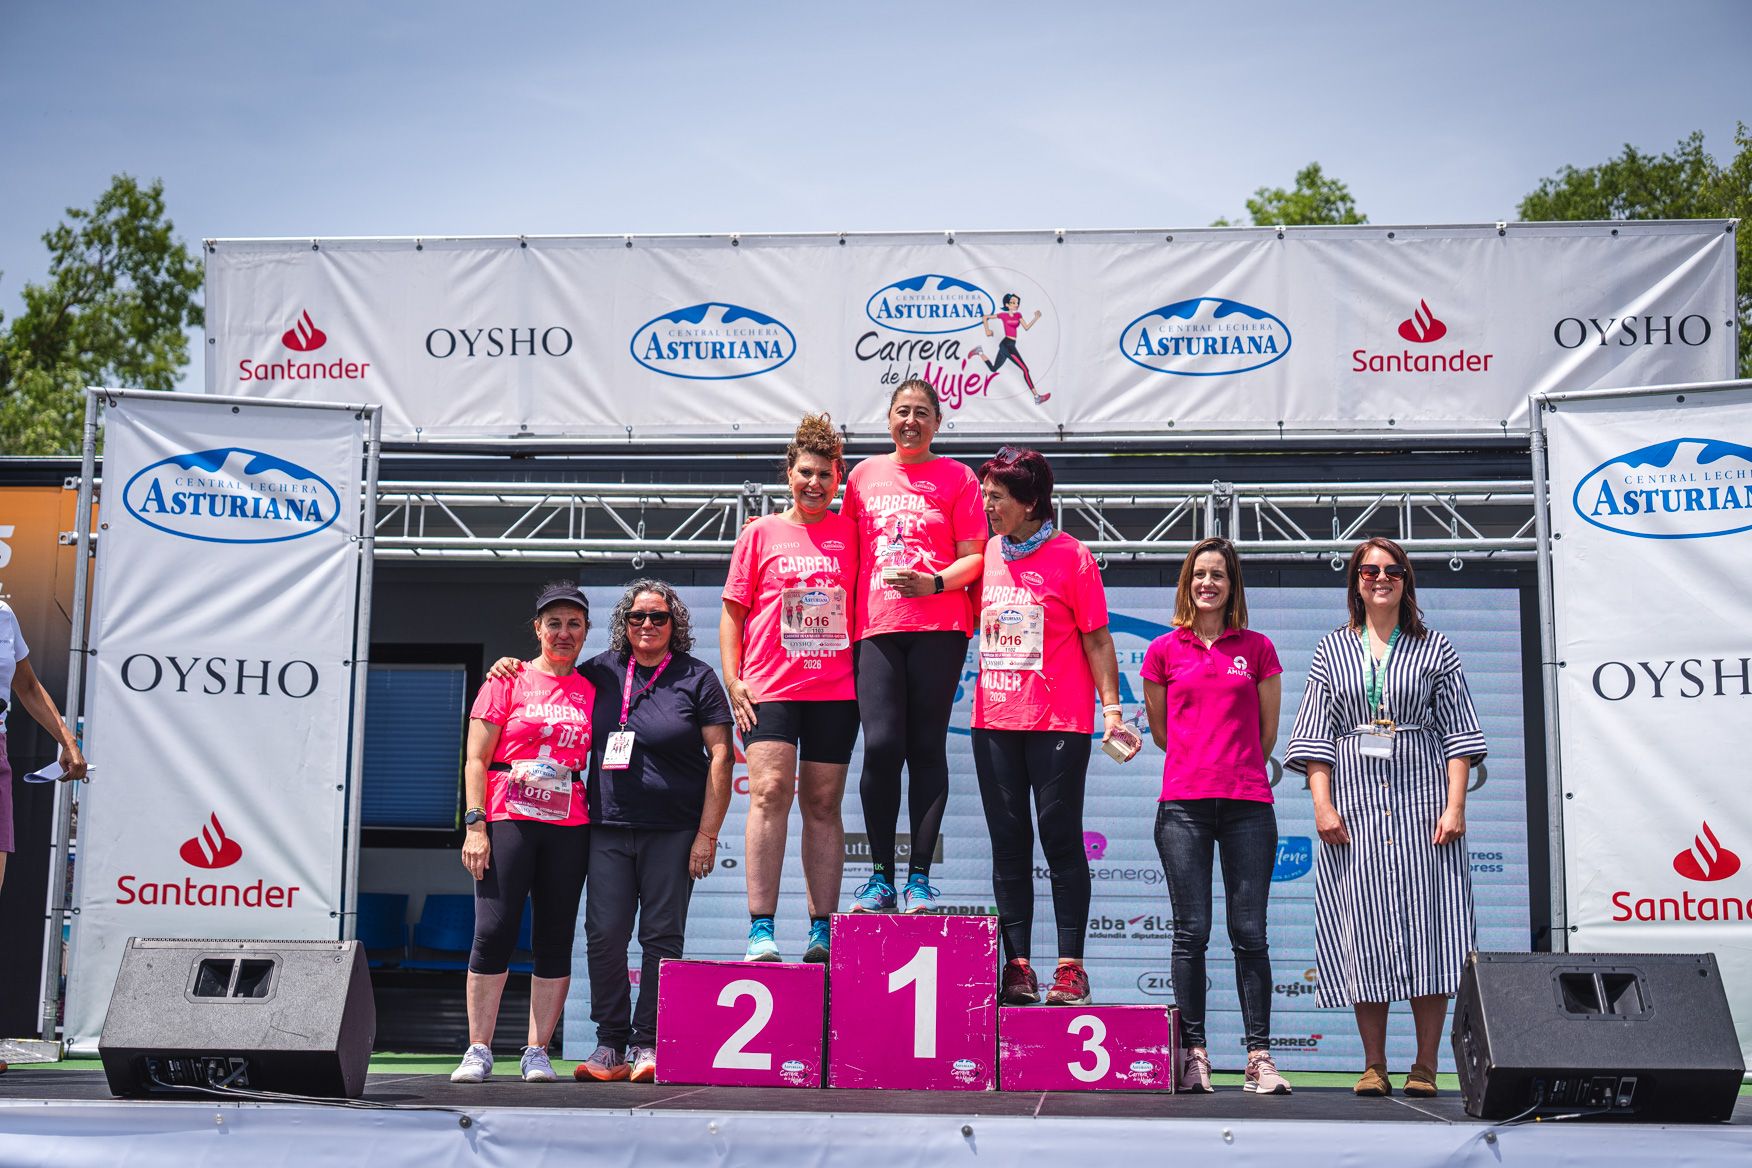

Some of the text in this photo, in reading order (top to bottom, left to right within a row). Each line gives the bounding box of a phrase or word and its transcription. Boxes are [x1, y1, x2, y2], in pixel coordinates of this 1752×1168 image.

[876, 297, 985, 319] ASTURIANA
[668, 328, 779, 337] CENTRAL LECHERA
[1159, 322, 1273, 333] CENTRAL LECHERA
[1553, 314, 1712, 349] OYSHO
[425, 326, 573, 359] OYSHO
[643, 331, 784, 360] ASTURIANA
[855, 331, 960, 361] Carrera
[1133, 327, 1280, 356] ASTURIANA
[239, 357, 370, 382] Santander
[1352, 349, 1494, 372] Santander
[880, 359, 1000, 410] de la Mujer
[175, 477, 319, 494] CENTRAL LECHERA
[1624, 468, 1752, 485] CENTRAL LECH
[139, 477, 324, 523] ASTURIANA
[1590, 479, 1752, 517] ASTURIA
[772, 541, 800, 551] OYSHO
[804, 616, 829, 627] 016
[1000, 635, 1022, 645] 016
[120, 653, 319, 699] OYSHO
[980, 670, 1022, 692] MUJER
[1592, 657, 1752, 701] OYSH
[524, 786, 552, 800] 016
[1468, 851, 1503, 860] rreos
[116, 875, 300, 909] Santander
[1611, 890, 1752, 922] Santan
[1089, 915, 1174, 930] aba ála
[1131, 932, 1174, 940] diputació
[888, 946, 938, 1058] 1
[712, 979, 773, 1070] 2
[1066, 1014, 1111, 1082] 3
[1270, 1038, 1318, 1046] ORREO
